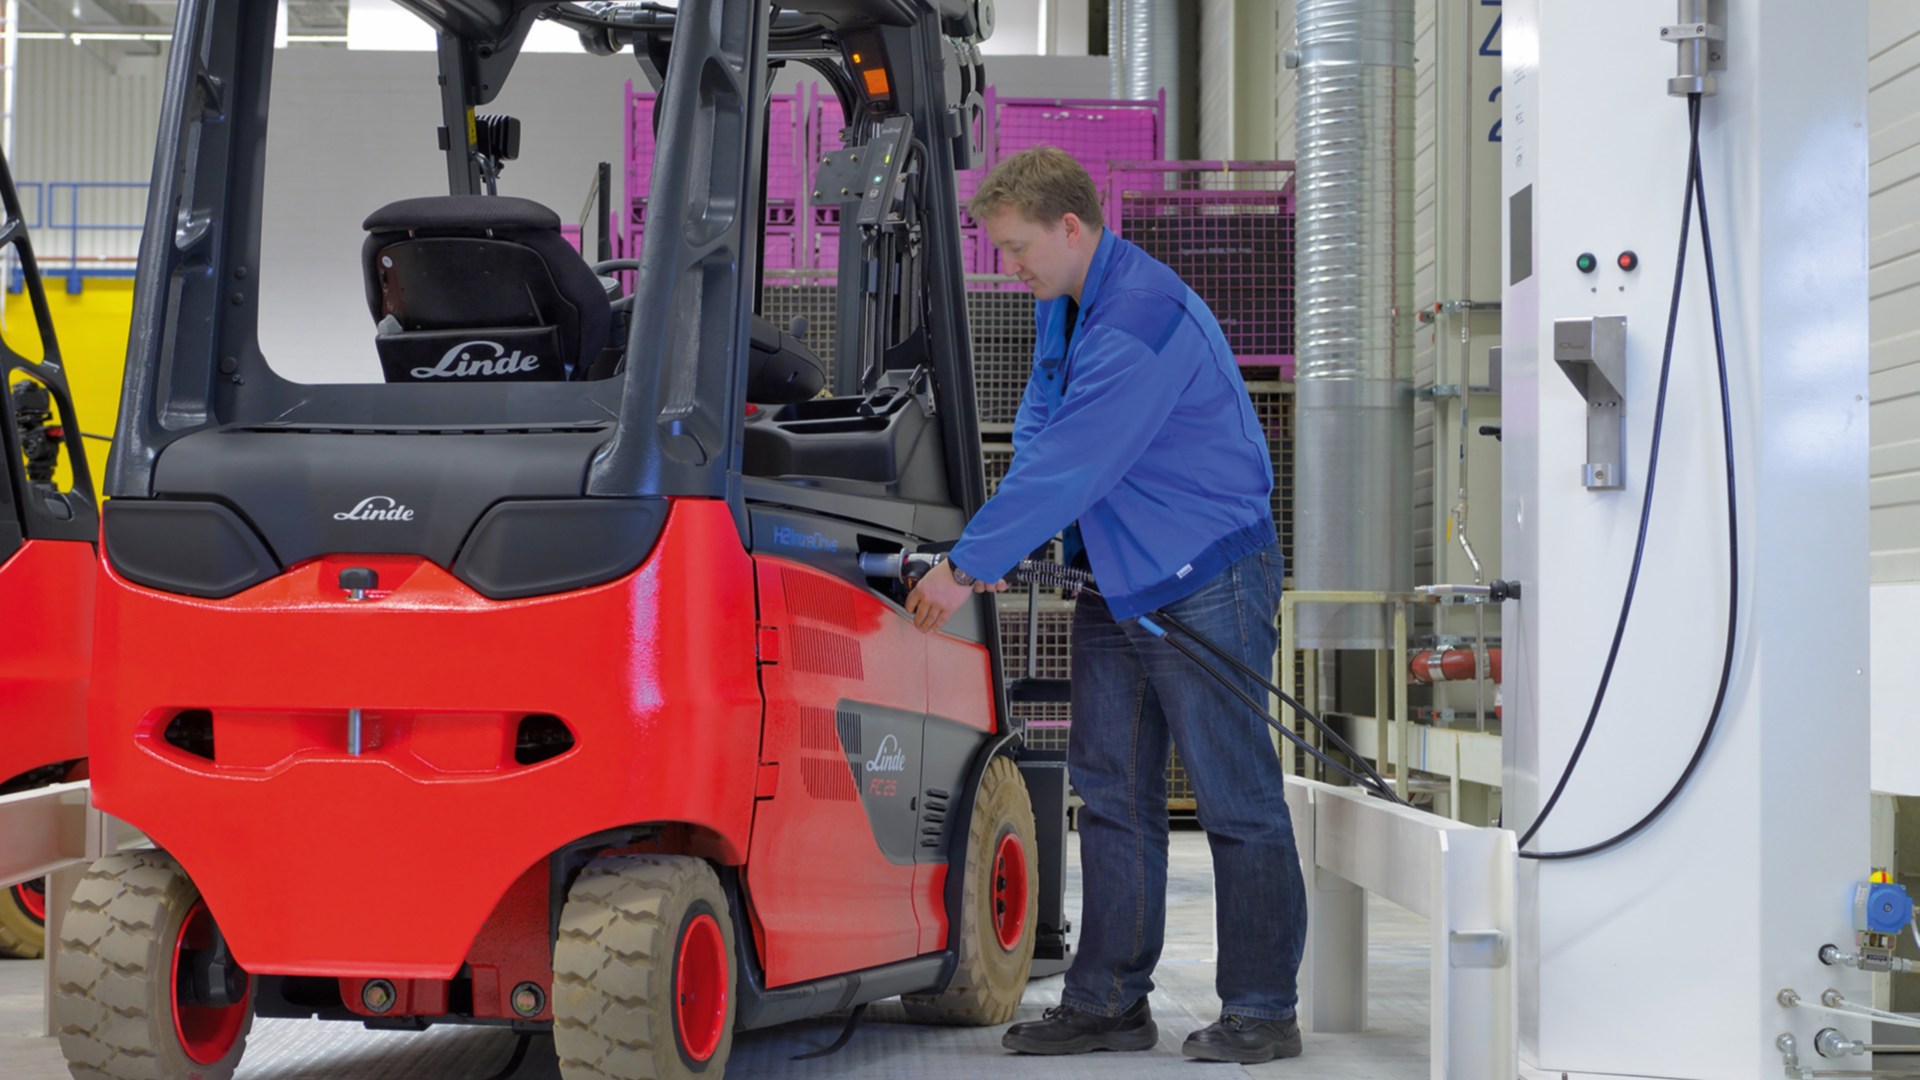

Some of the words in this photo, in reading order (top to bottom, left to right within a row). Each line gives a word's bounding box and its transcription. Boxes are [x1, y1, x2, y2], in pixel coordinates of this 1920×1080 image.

[410, 340, 540, 378] Linde
[333, 495, 414, 521] Linde
[865, 734, 906, 772] Linde
